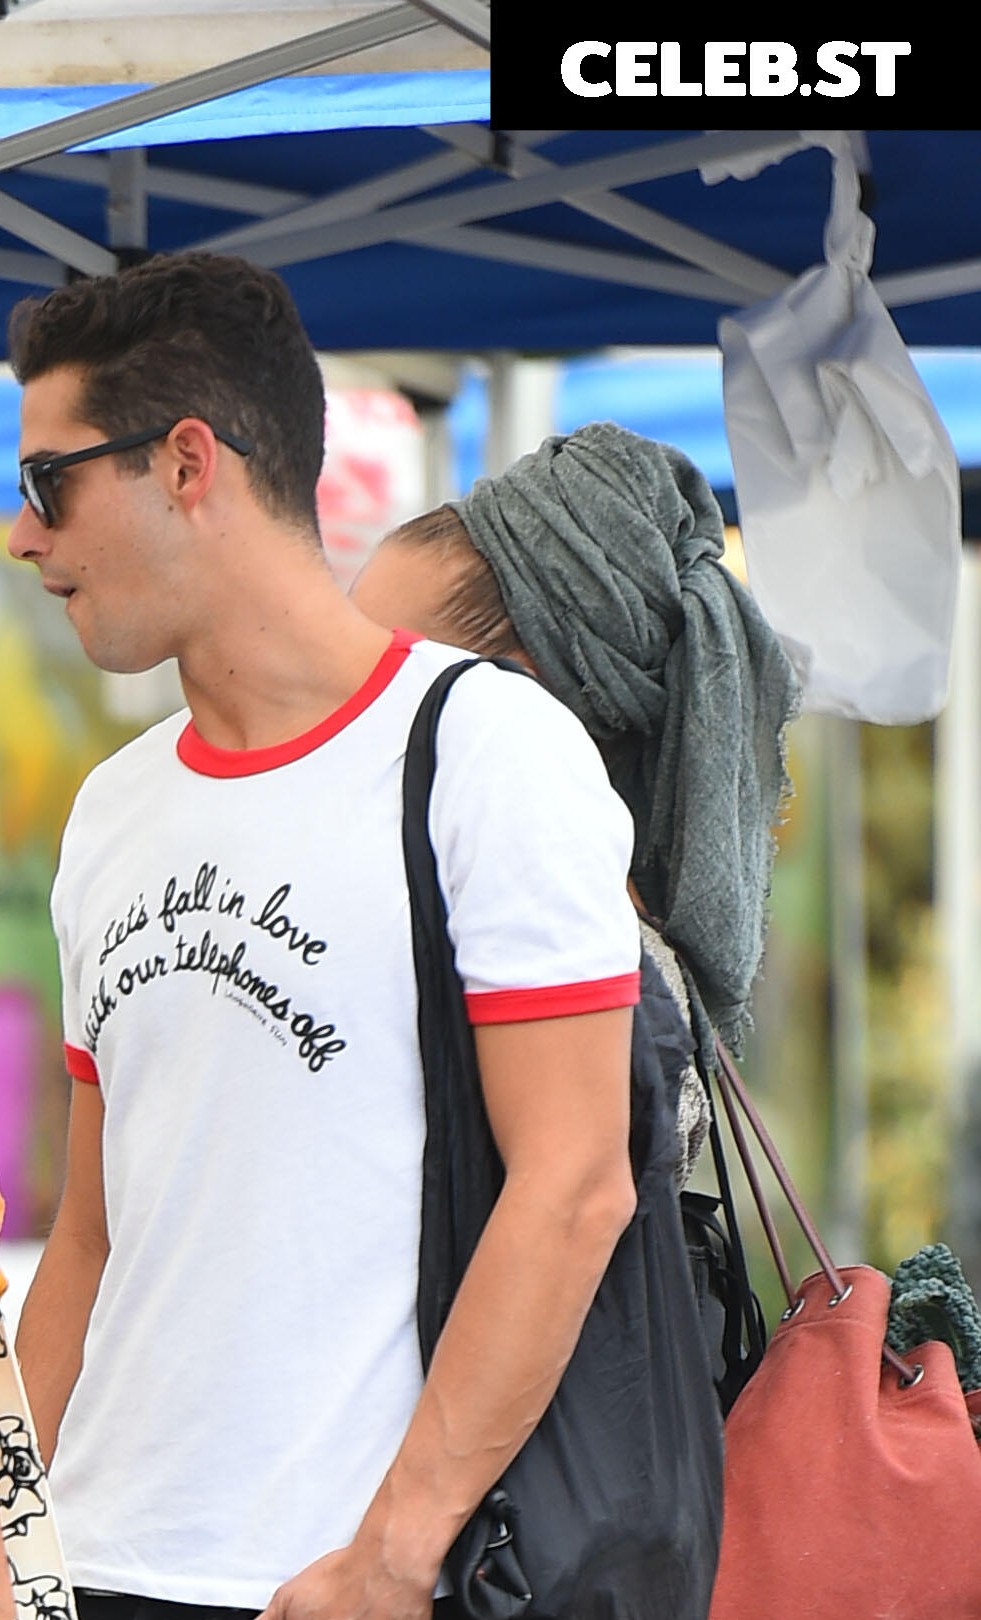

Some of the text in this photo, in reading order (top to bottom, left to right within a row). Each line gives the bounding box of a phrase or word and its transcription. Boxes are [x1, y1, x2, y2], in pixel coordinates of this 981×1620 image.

[99, 862, 327, 966] Let's fall in love
[117, 955, 168, 995] our
[173, 930, 290, 1021] telephones
[291, 1012, 347, 1073] off
